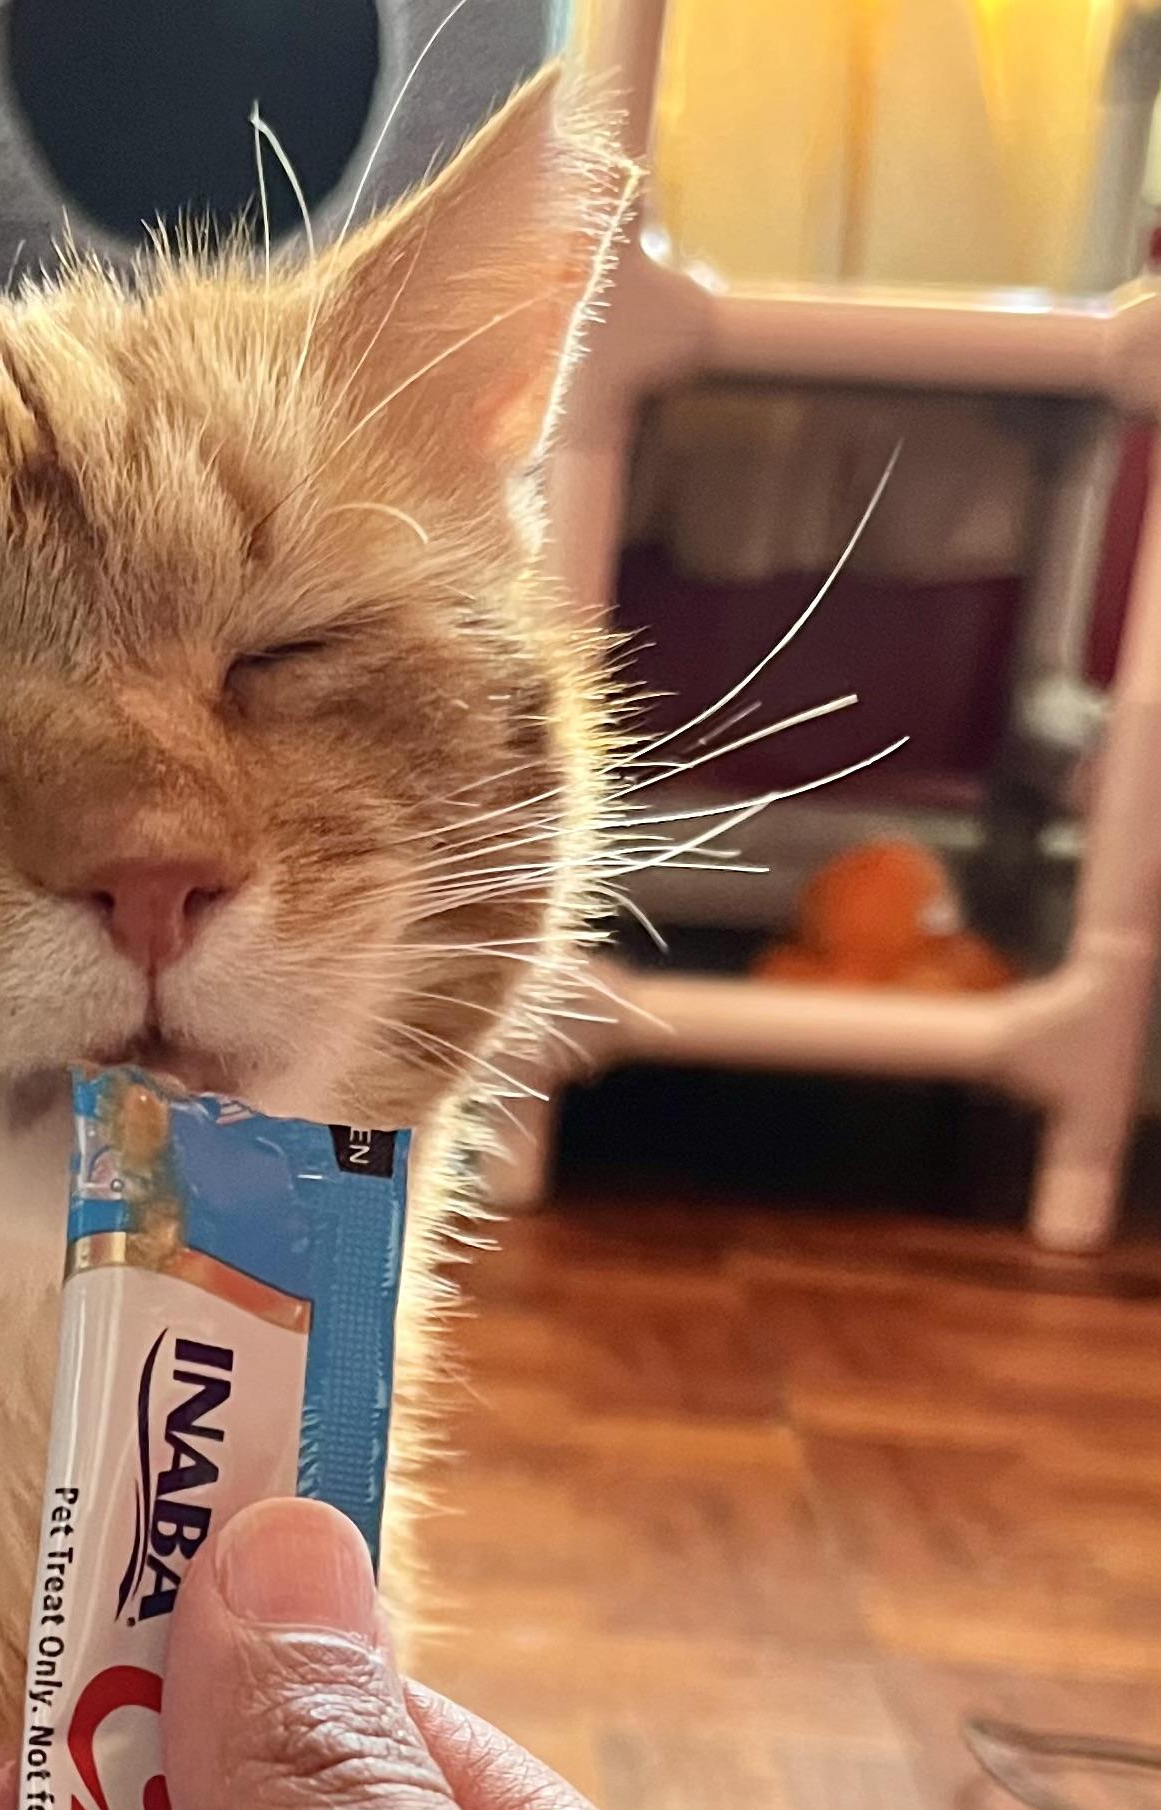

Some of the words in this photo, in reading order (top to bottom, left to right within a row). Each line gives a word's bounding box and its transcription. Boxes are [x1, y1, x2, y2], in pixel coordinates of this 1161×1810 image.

[50, 1487, 79, 1537] Pet
[139, 1338, 234, 1621] INABA
[41, 1547, 73, 1626] Treat
[29, 1636, 64, 1712] Only.
[26, 1725, 55, 1782] Not
